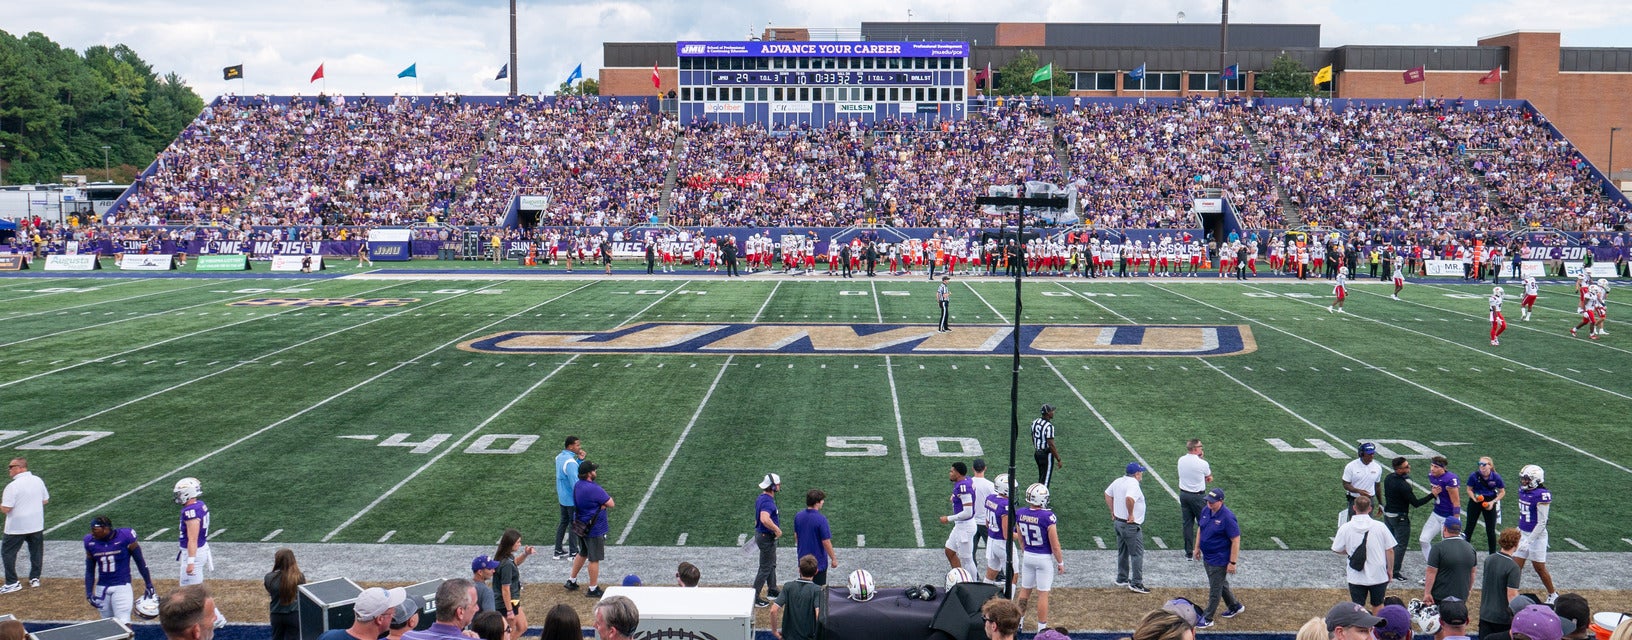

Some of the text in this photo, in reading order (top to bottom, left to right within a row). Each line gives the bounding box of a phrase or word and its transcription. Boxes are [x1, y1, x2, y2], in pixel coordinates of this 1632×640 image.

[682, 45, 706, 54] JMU
[760, 44, 901, 54] ADVANCE YOUR CAREER
[736, 73, 748, 82] 29
[798, 76, 806, 84] 10
[816, 74, 835, 82] 0:33
[838, 76, 849, 84] 32
[858, 76, 863, 84] 2
[457, 322, 1258, 356] JMU
[1035, 424, 1042, 438] S
[377, 433, 540, 454] 40
[825, 436, 984, 457] 50
[184, 509, 196, 518] 48
[1019, 522, 1043, 546] 93
[100, 556, 116, 572] 11
